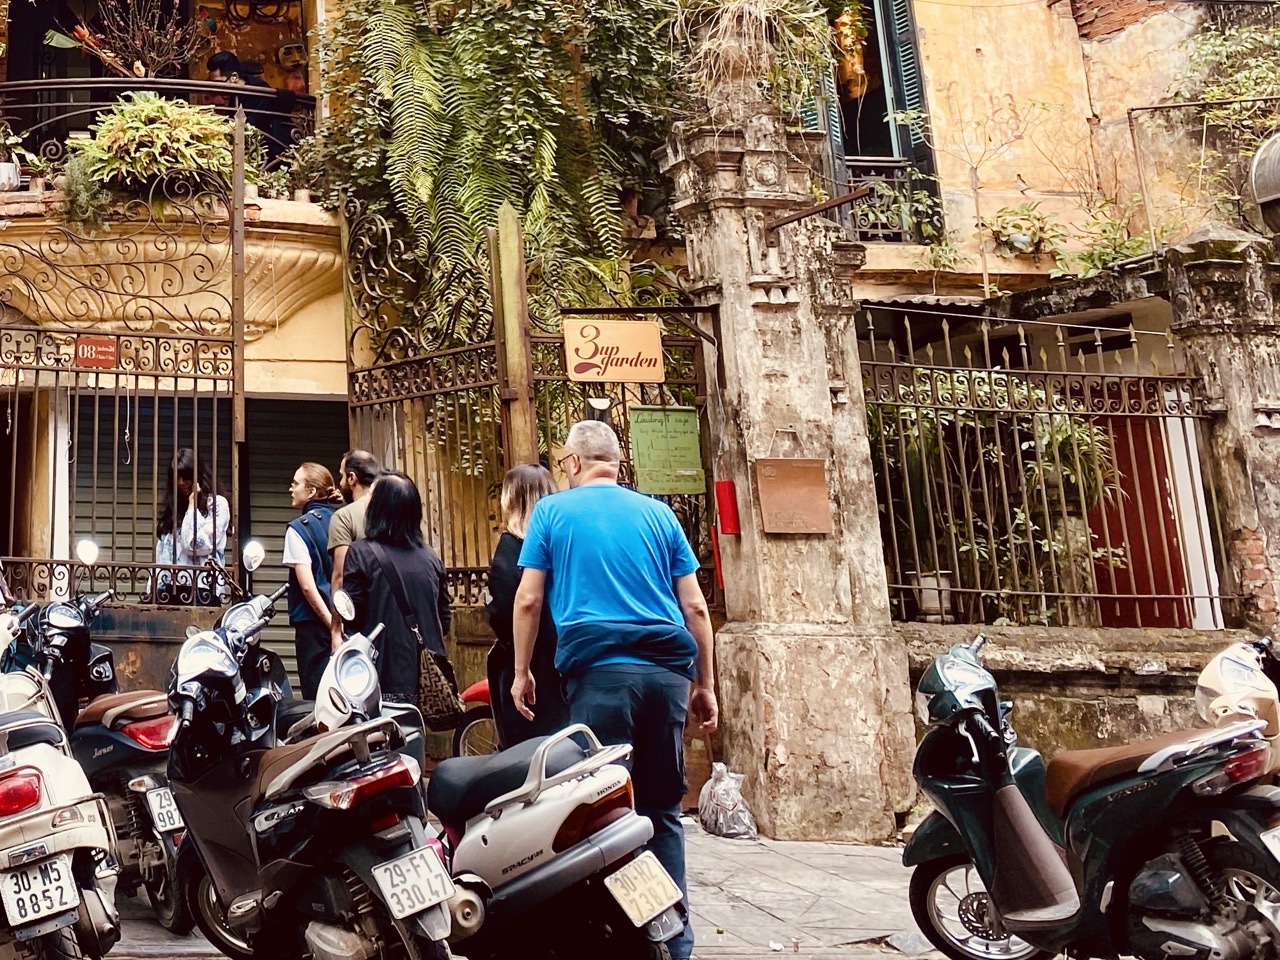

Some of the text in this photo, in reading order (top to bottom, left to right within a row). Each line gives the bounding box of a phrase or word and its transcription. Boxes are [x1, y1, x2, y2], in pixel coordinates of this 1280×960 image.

[79, 344, 96, 359] 08
[597, 780, 622, 797] HONDA
[10, 860, 61, 895] 30-M5
[383, 852, 433, 889] 29-F1
[16, 885, 68, 919] 8852
[390, 872, 449, 914] 330.47
